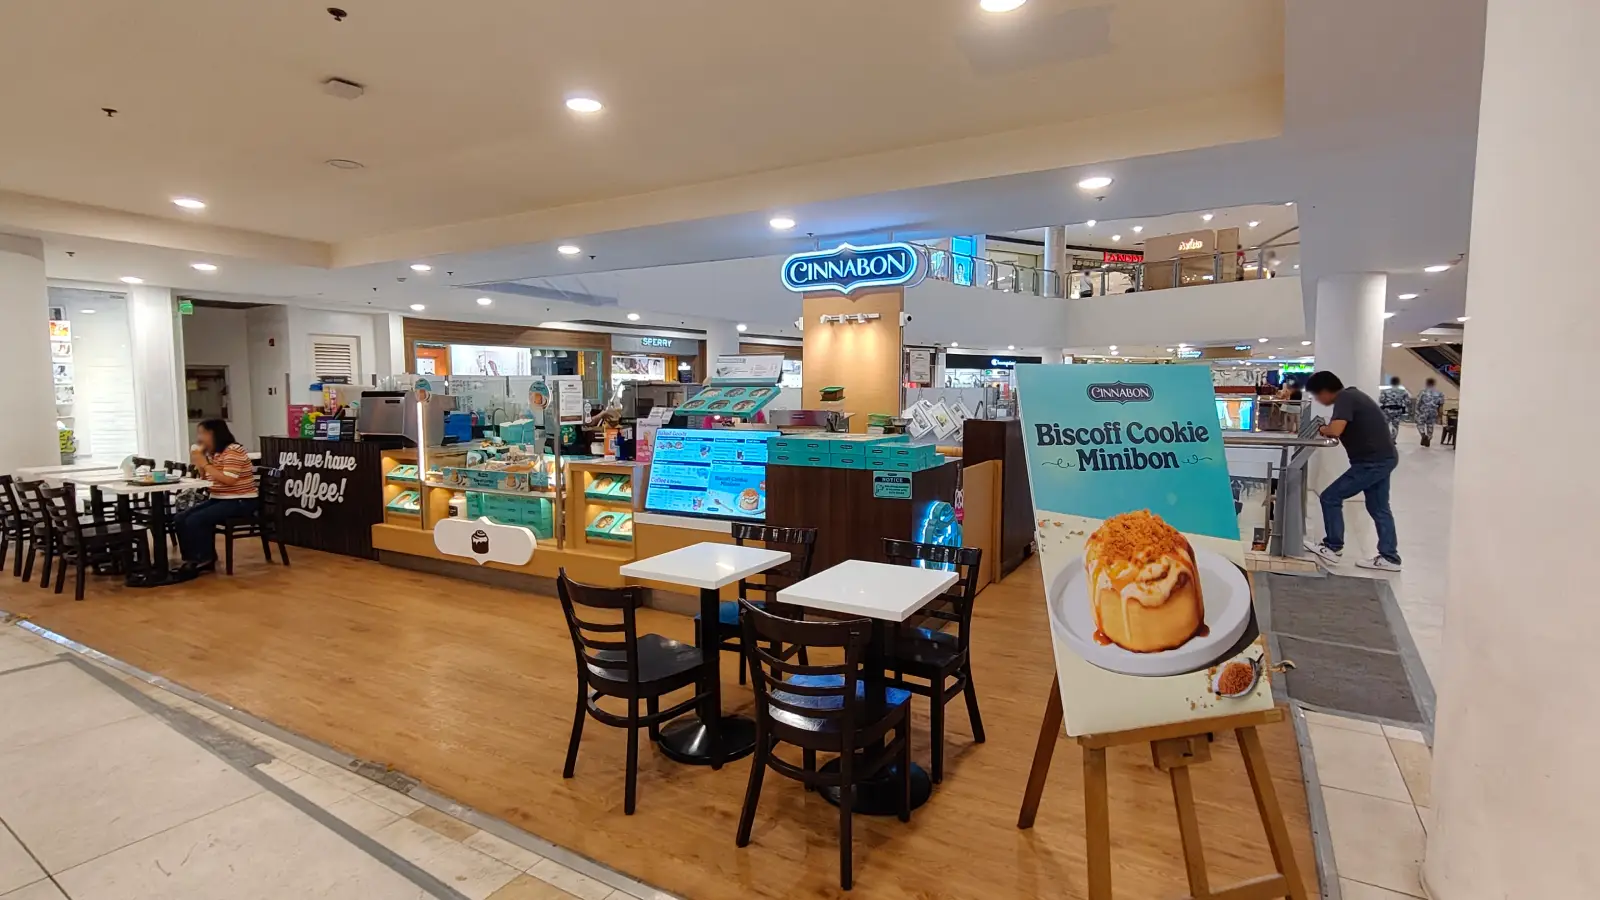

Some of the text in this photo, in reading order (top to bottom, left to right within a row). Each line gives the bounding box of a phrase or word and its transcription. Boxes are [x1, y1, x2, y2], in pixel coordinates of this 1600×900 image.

[790, 252, 906, 284] CINNABON
[642, 337, 672, 347] SPERRY
[1091, 387, 1150, 399] CINNABON
[1034, 420, 1210, 446] Biscoff Cookie
[279, 450, 357, 471] yes, we have
[1076, 448, 1180, 472] Minibon
[284, 471, 347, 509] coffee!
